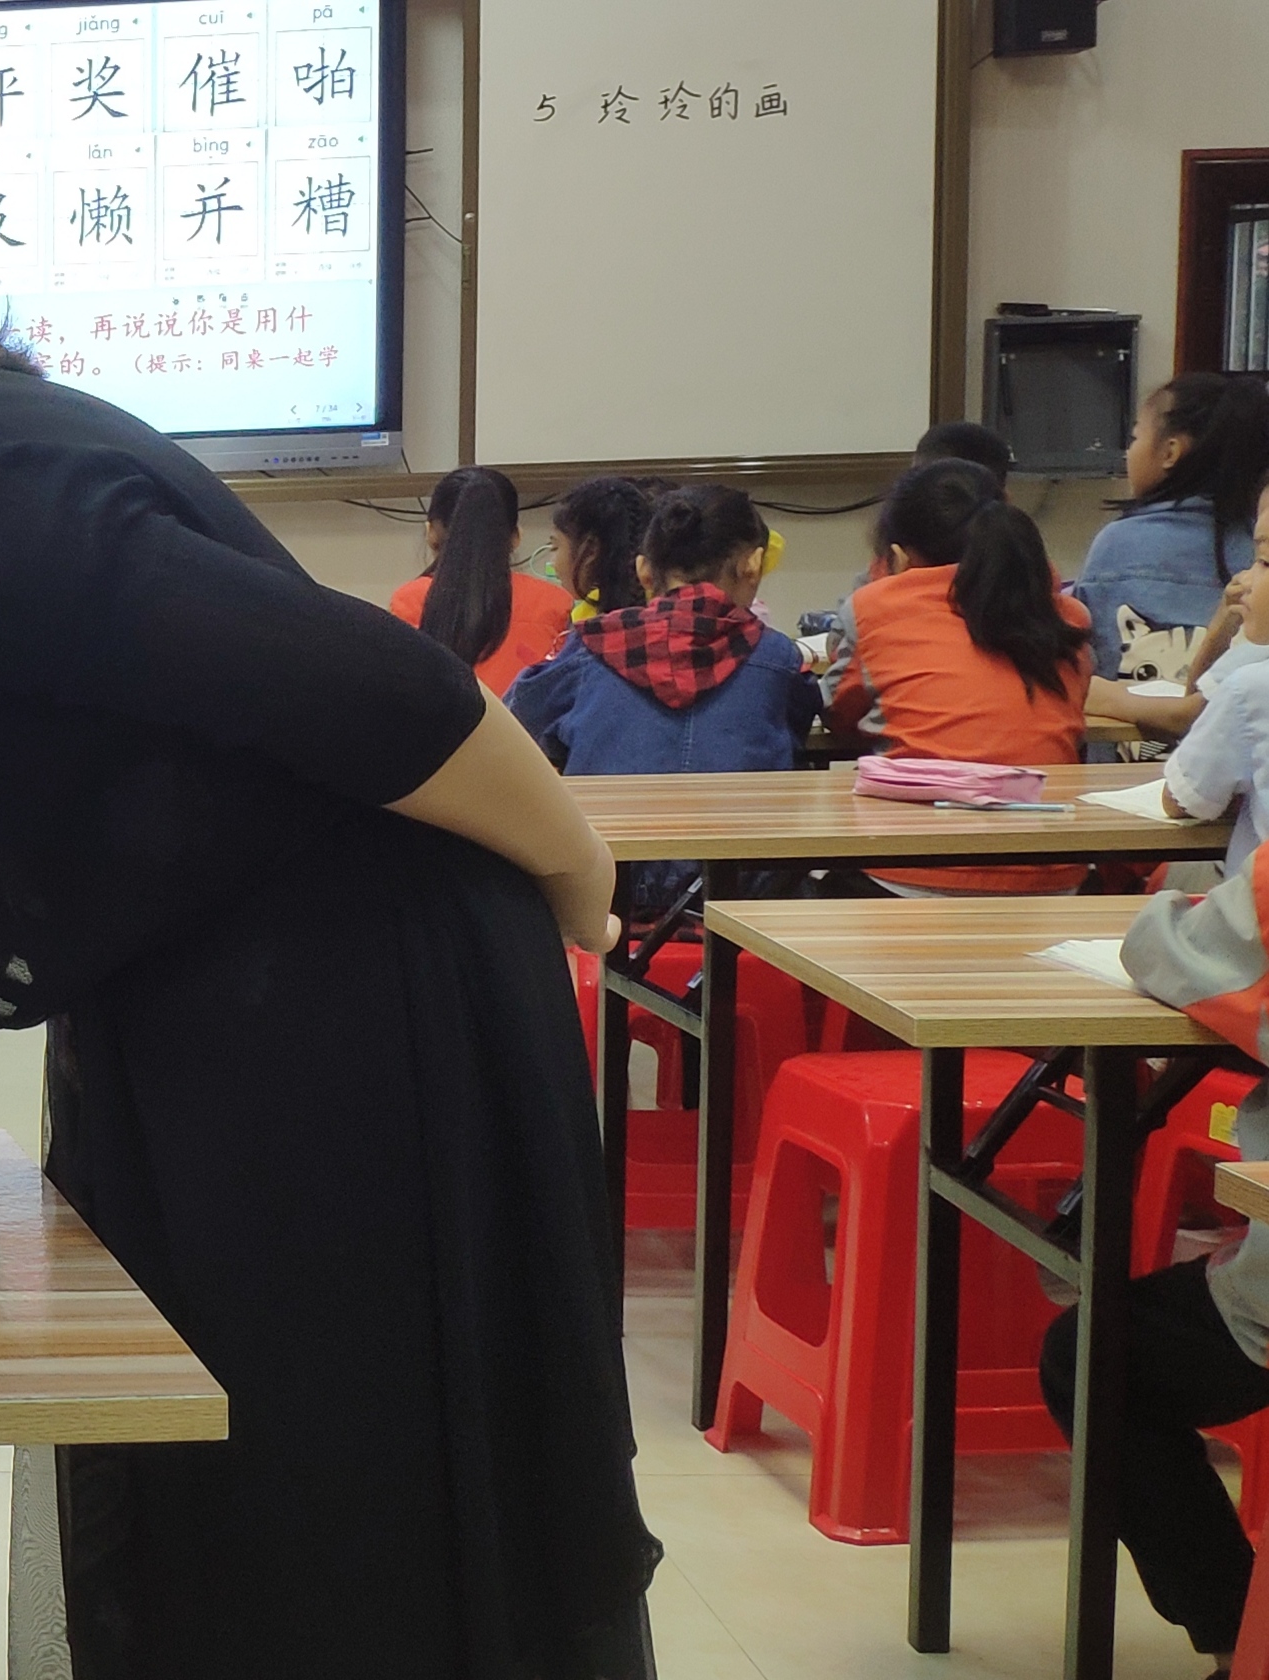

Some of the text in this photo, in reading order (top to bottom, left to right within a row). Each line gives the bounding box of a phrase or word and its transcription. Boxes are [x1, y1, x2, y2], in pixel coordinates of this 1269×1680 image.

[69, 56, 129, 121] 奖
[179, 49, 246, 117] 催
[293, 46, 356, 106] 啪
[533, 80, 788, 124] 5 玲玲的画
[69, 184, 133, 247] 懒
[180, 177, 244, 245] 并
[291, 173, 356, 237] 糟
